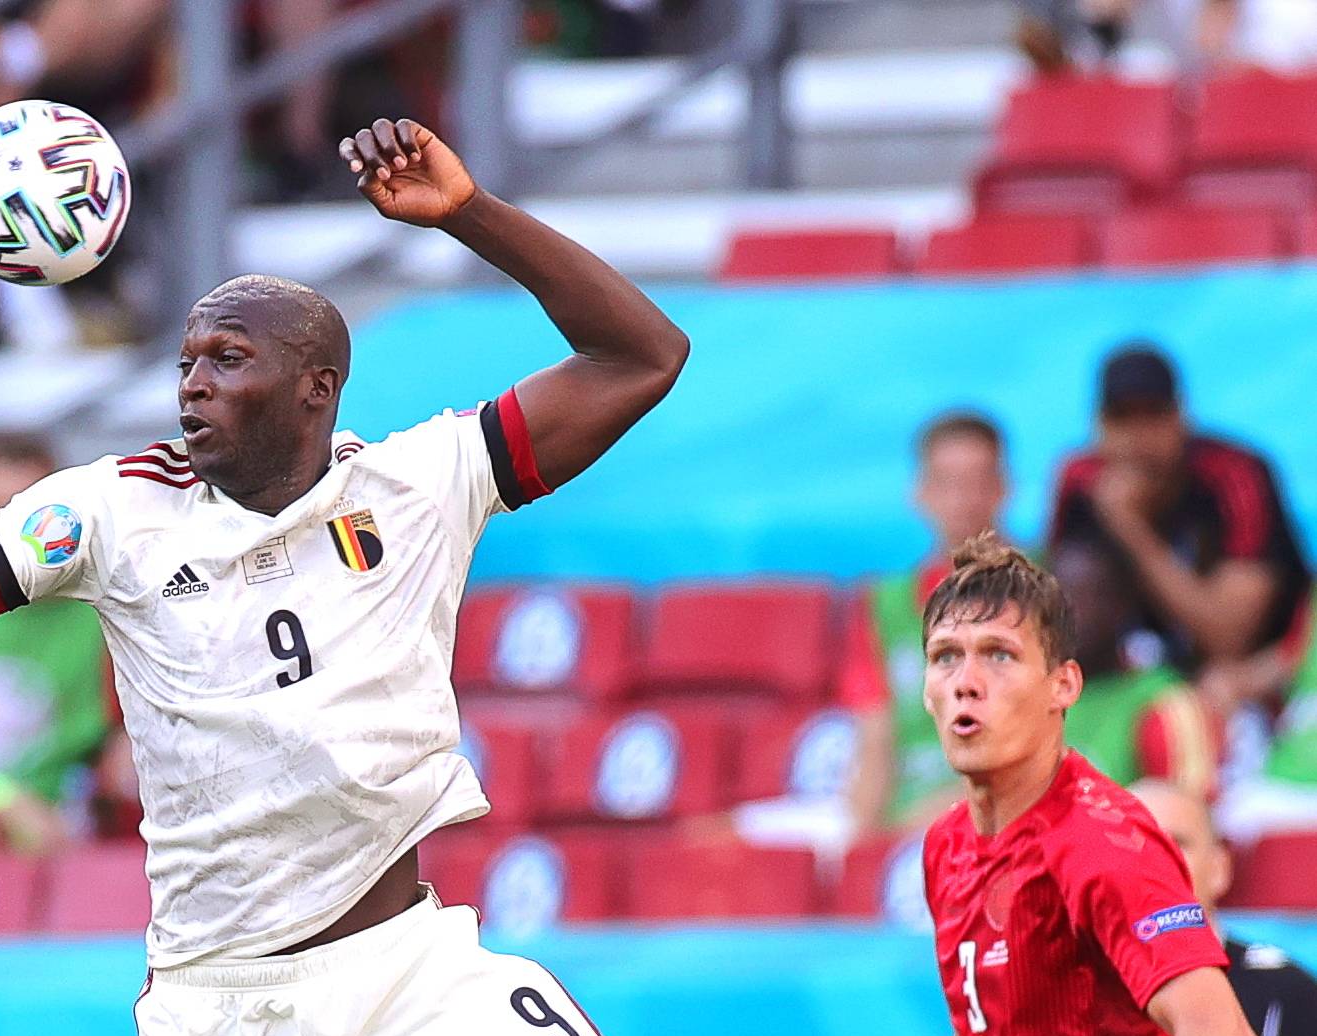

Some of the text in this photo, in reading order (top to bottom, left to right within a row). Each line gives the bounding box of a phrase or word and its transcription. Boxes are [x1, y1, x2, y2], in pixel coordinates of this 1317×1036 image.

[162, 581, 210, 598] adidas
[265, 608, 313, 689] 9
[1156, 907, 1204, 929] RESPECT
